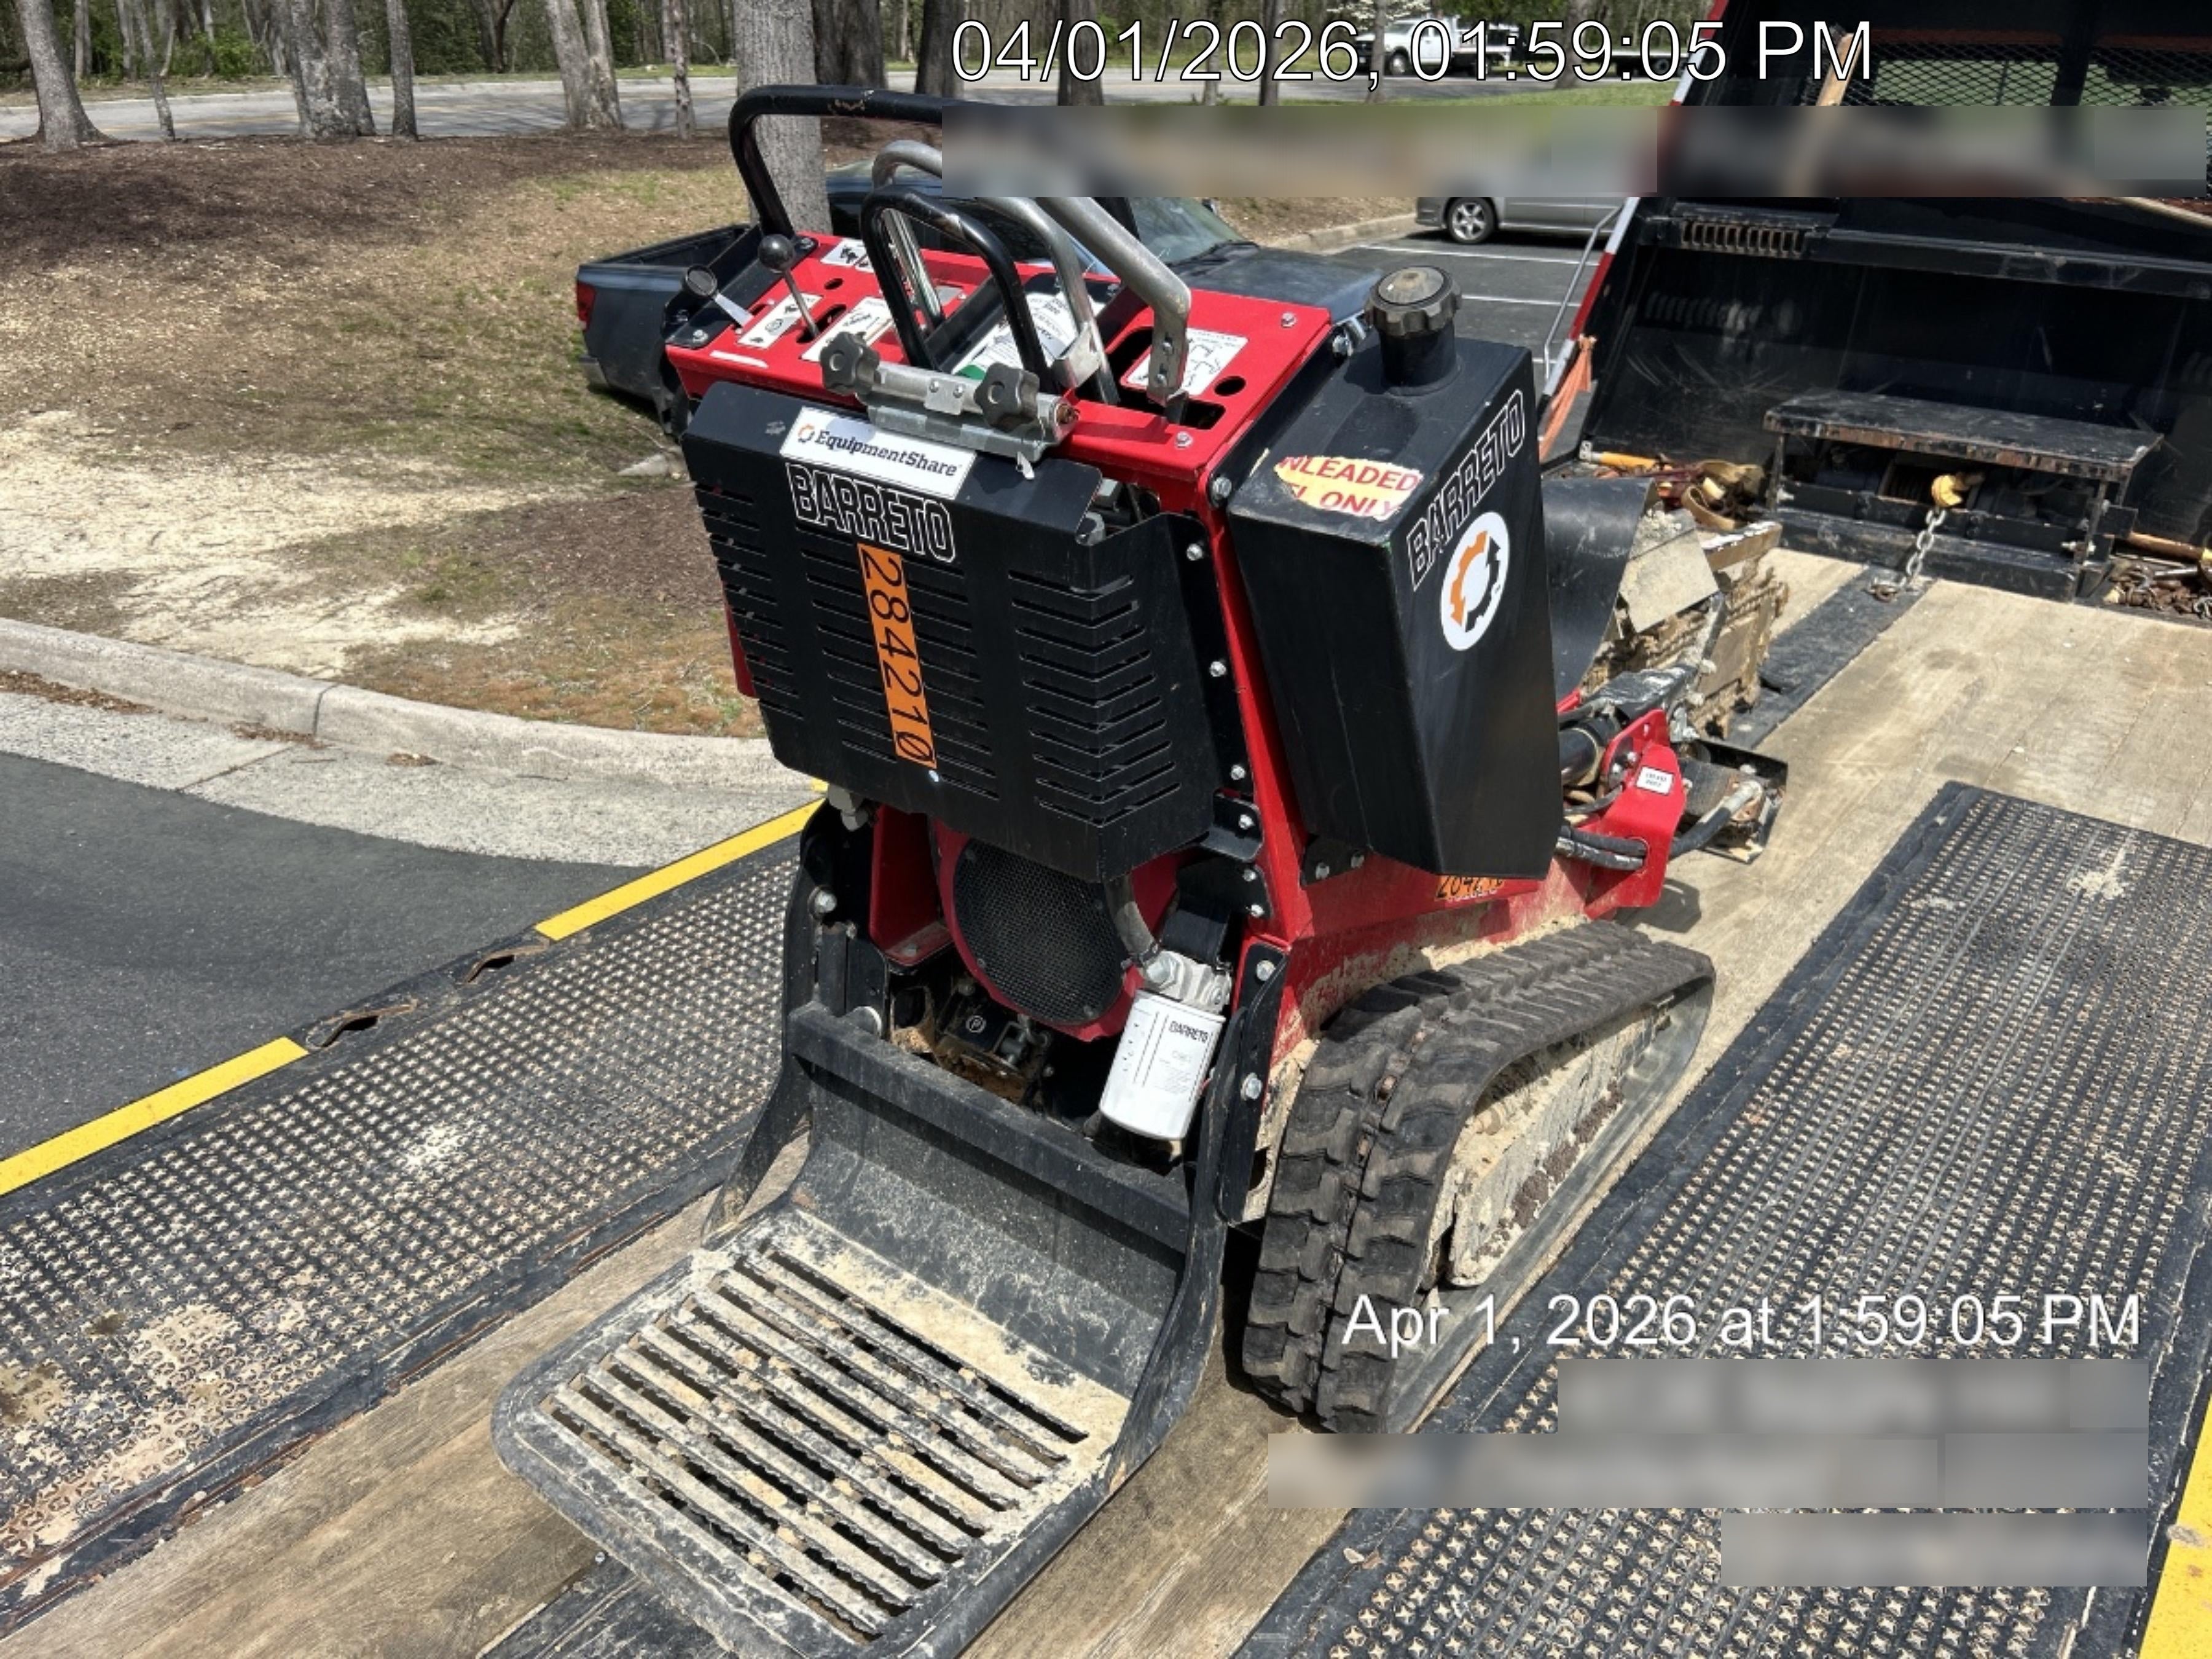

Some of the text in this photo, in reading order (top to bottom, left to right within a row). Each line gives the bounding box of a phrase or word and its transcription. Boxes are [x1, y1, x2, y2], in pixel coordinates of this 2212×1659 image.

[785, 462, 955, 563] BARRETO
[814, 429, 957, 477] EquipmentShare
[1406, 389, 1525, 591] BARRETO
[860, 549, 934, 763] 284210
